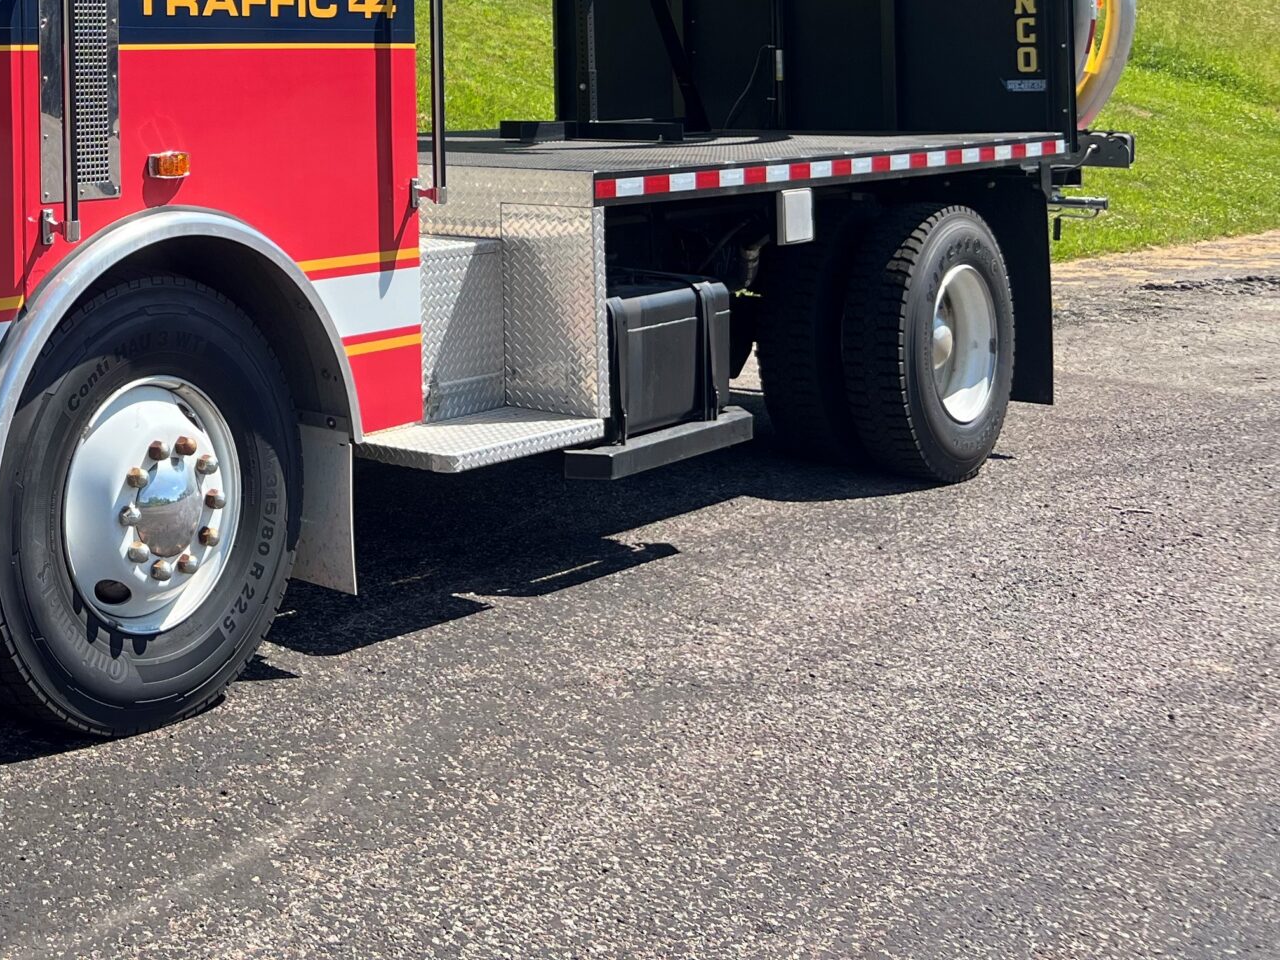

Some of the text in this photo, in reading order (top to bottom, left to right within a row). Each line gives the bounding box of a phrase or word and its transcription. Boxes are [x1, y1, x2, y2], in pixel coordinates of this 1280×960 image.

[67, 356, 112, 413] Conti
[257, 473, 278, 557] 315/80
[250, 561, 265, 581] R
[223, 582, 255, 633] 22.5
